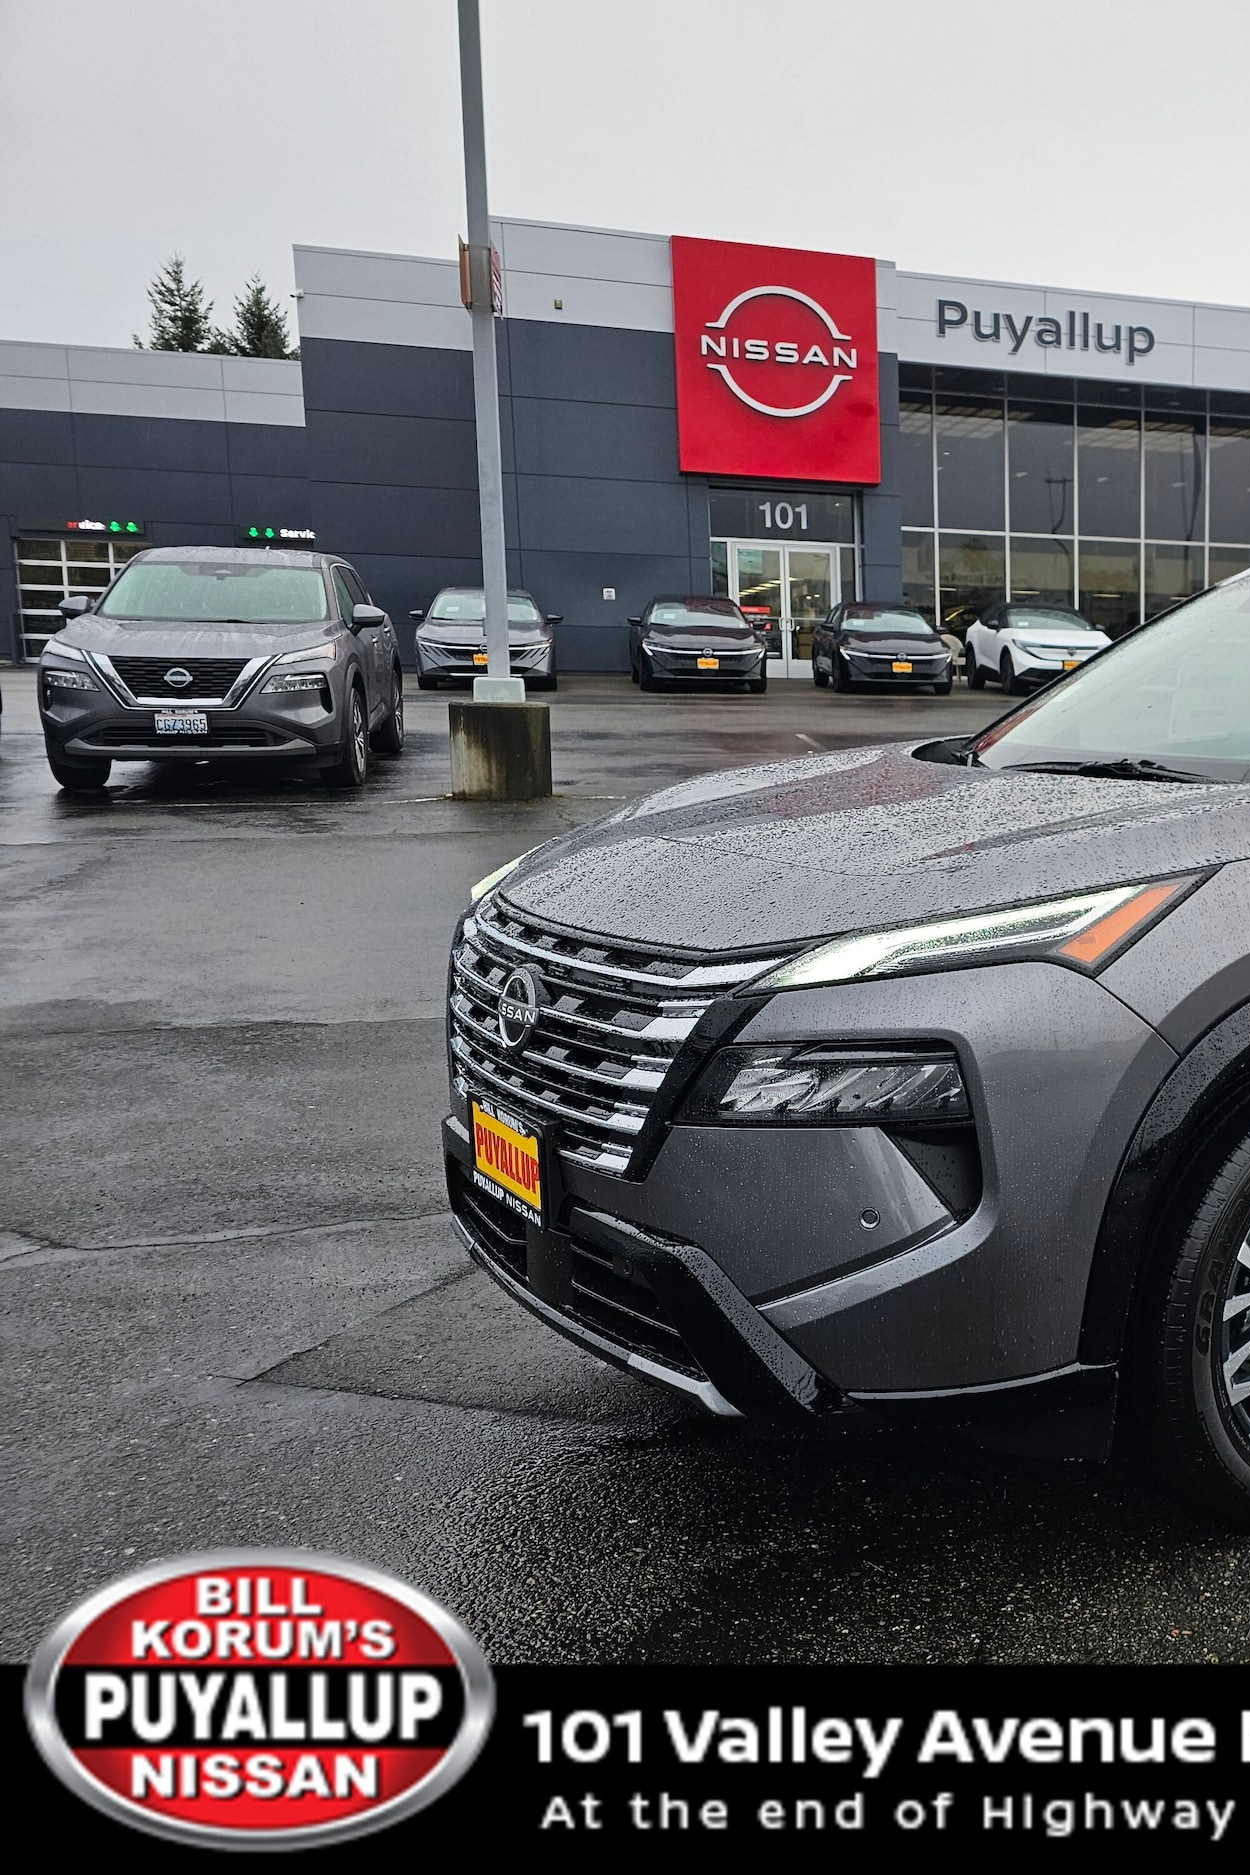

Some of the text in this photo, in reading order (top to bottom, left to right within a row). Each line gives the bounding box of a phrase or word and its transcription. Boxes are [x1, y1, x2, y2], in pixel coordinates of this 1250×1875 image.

[936, 299, 1156, 364] Puyallup
[700, 334, 858, 369] NISSAN
[759, 501, 808, 529] 101
[156, 719, 207, 732] CGZ3965
[501, 1003, 536, 1024] SSAN
[475, 1122, 540, 1195] PUYALLUP
[473, 1169, 542, 1227] PUYALLUP NISSAN
